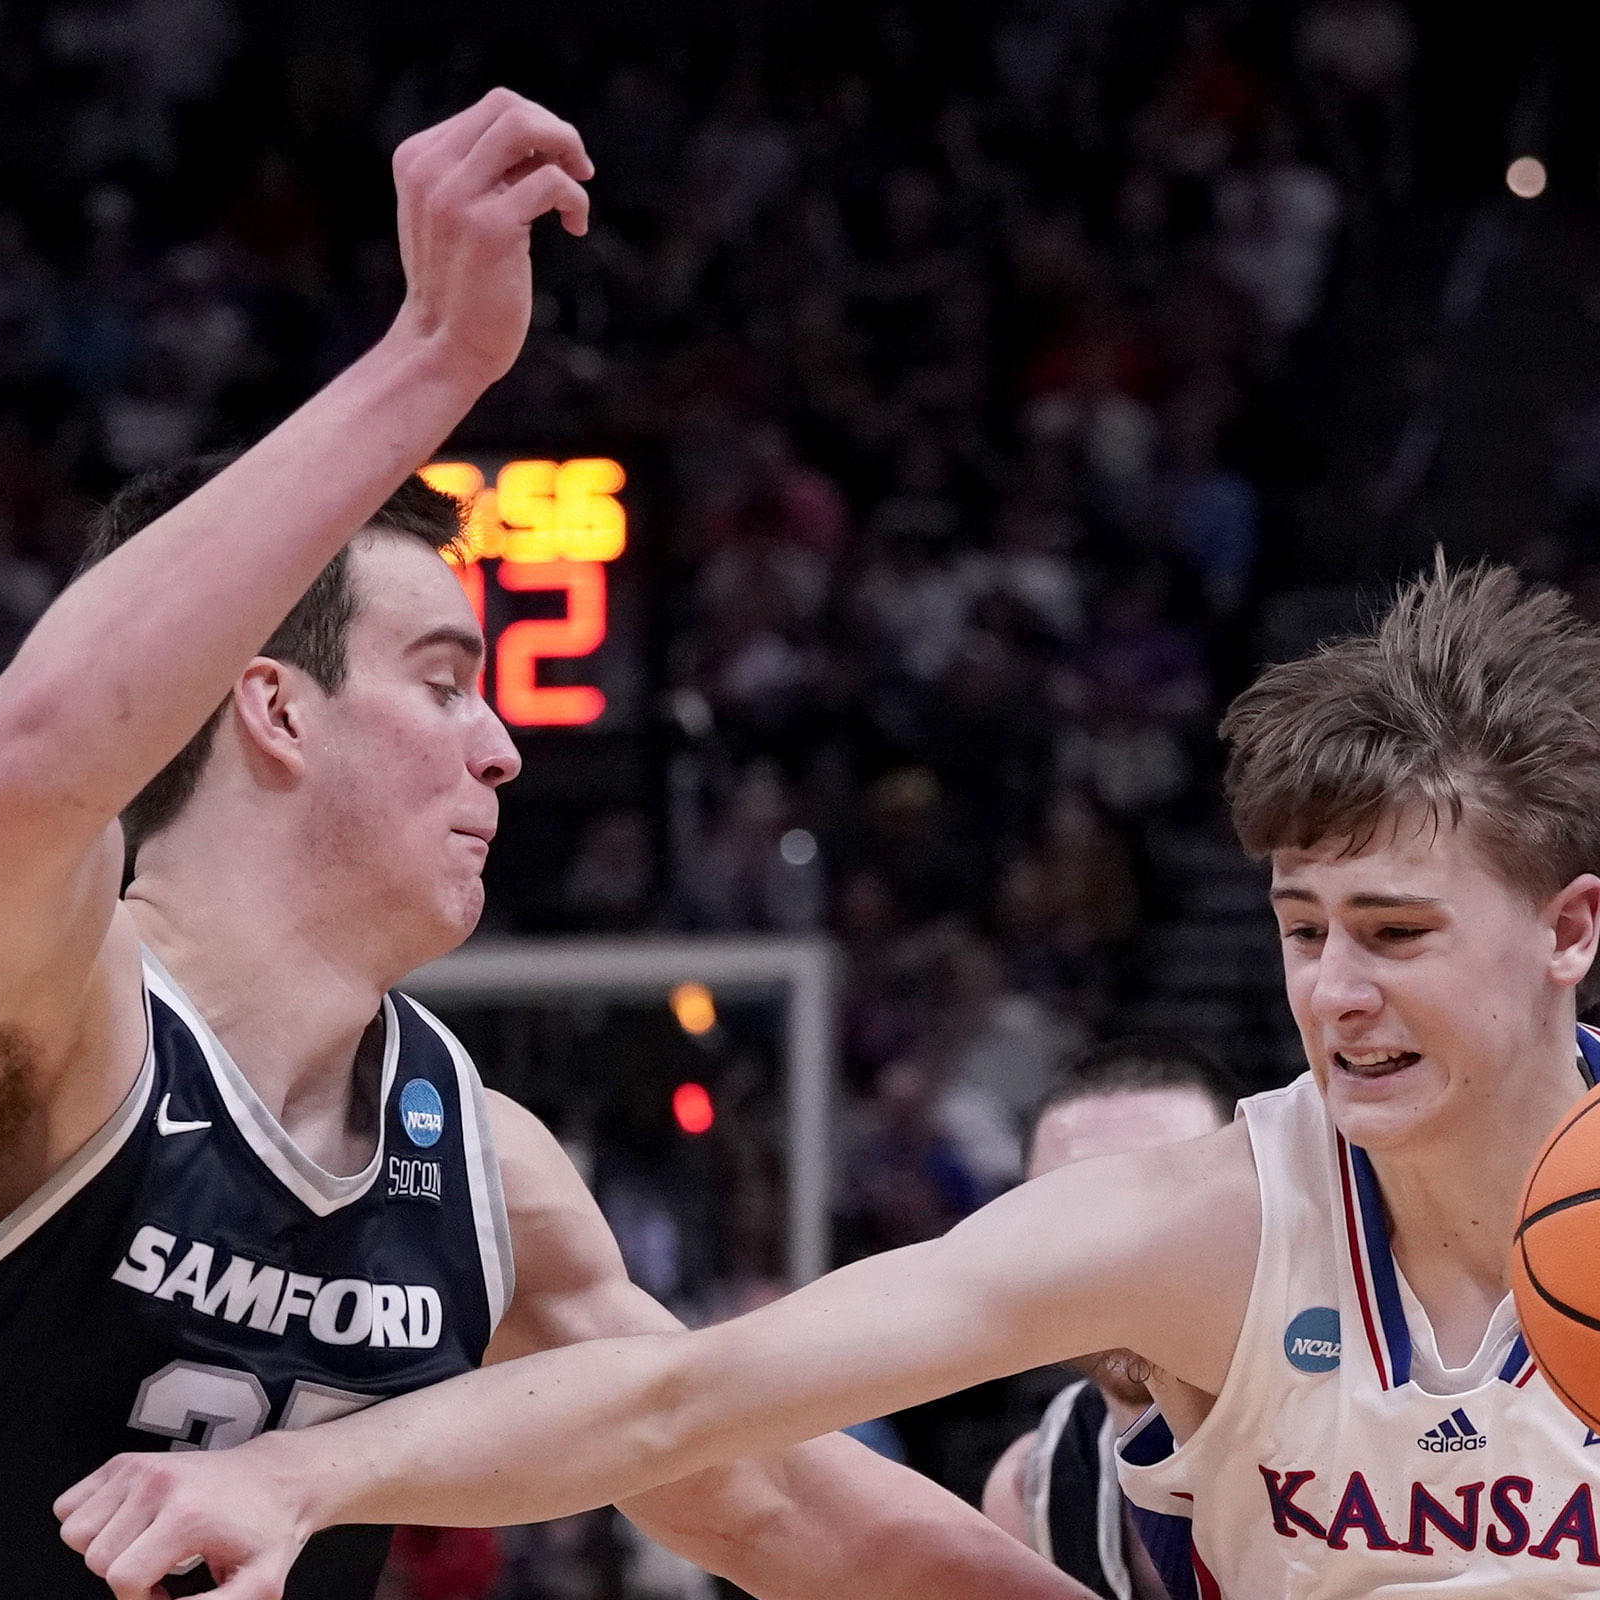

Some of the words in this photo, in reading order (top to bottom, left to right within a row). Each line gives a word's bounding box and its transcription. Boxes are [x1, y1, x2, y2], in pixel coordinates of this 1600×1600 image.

[406, 1110, 442, 1132] NCAA
[111, 1225, 442, 1349] SAMFORD
[1416, 1435, 1487, 1454] adidas
